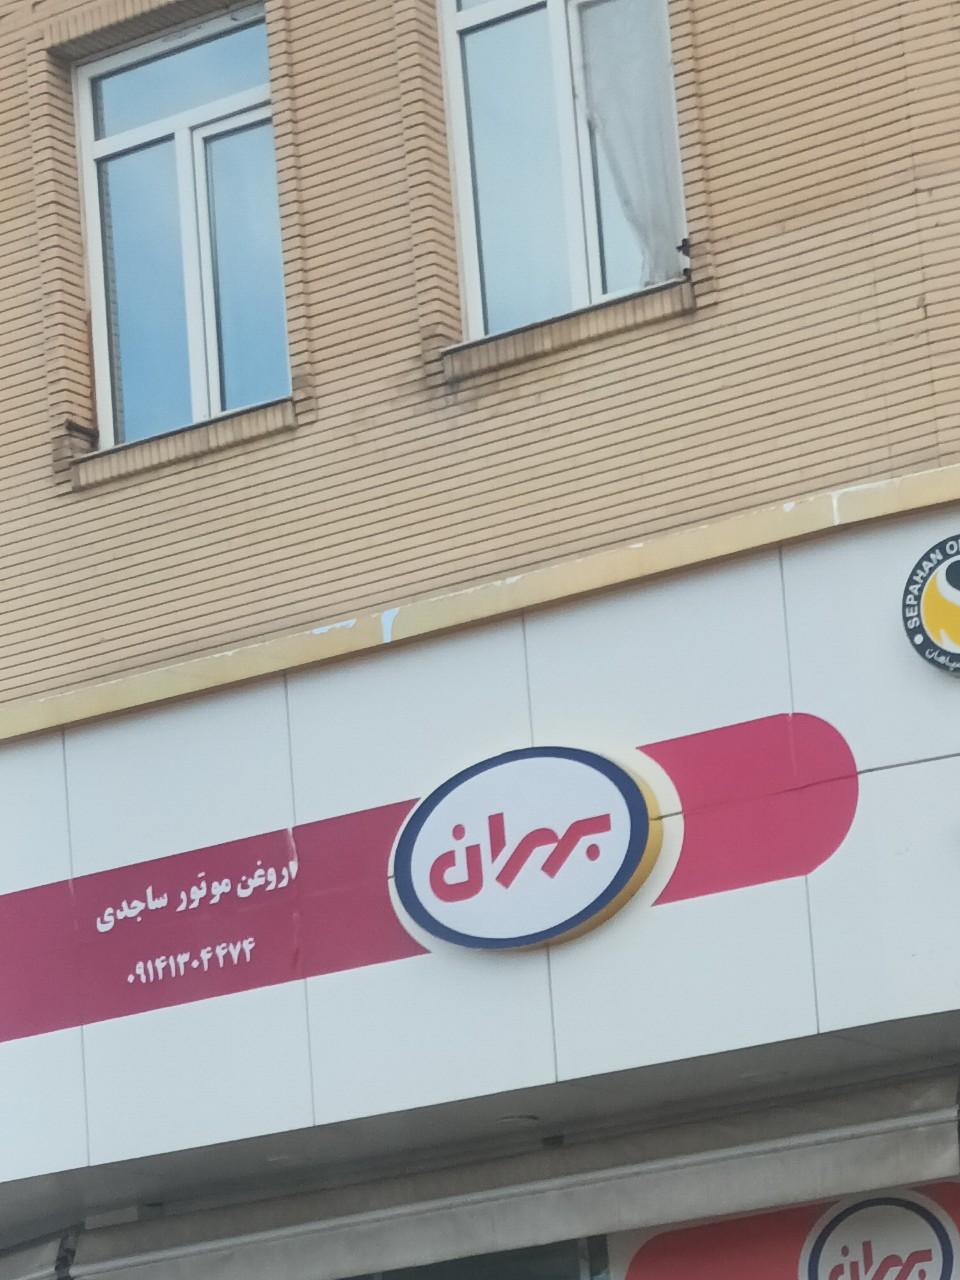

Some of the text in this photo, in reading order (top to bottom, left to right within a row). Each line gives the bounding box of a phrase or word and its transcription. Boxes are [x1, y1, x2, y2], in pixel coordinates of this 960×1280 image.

[905, 549, 943, 629] SEPAHAN
[428, 811, 612, 903] بهران
[96, 885, 169, 933] ساجدی
[176, 871, 231, 912] موتور
[127, 937, 256, 984] ۰۹۱۴۱۳۰۴۴۷۴
